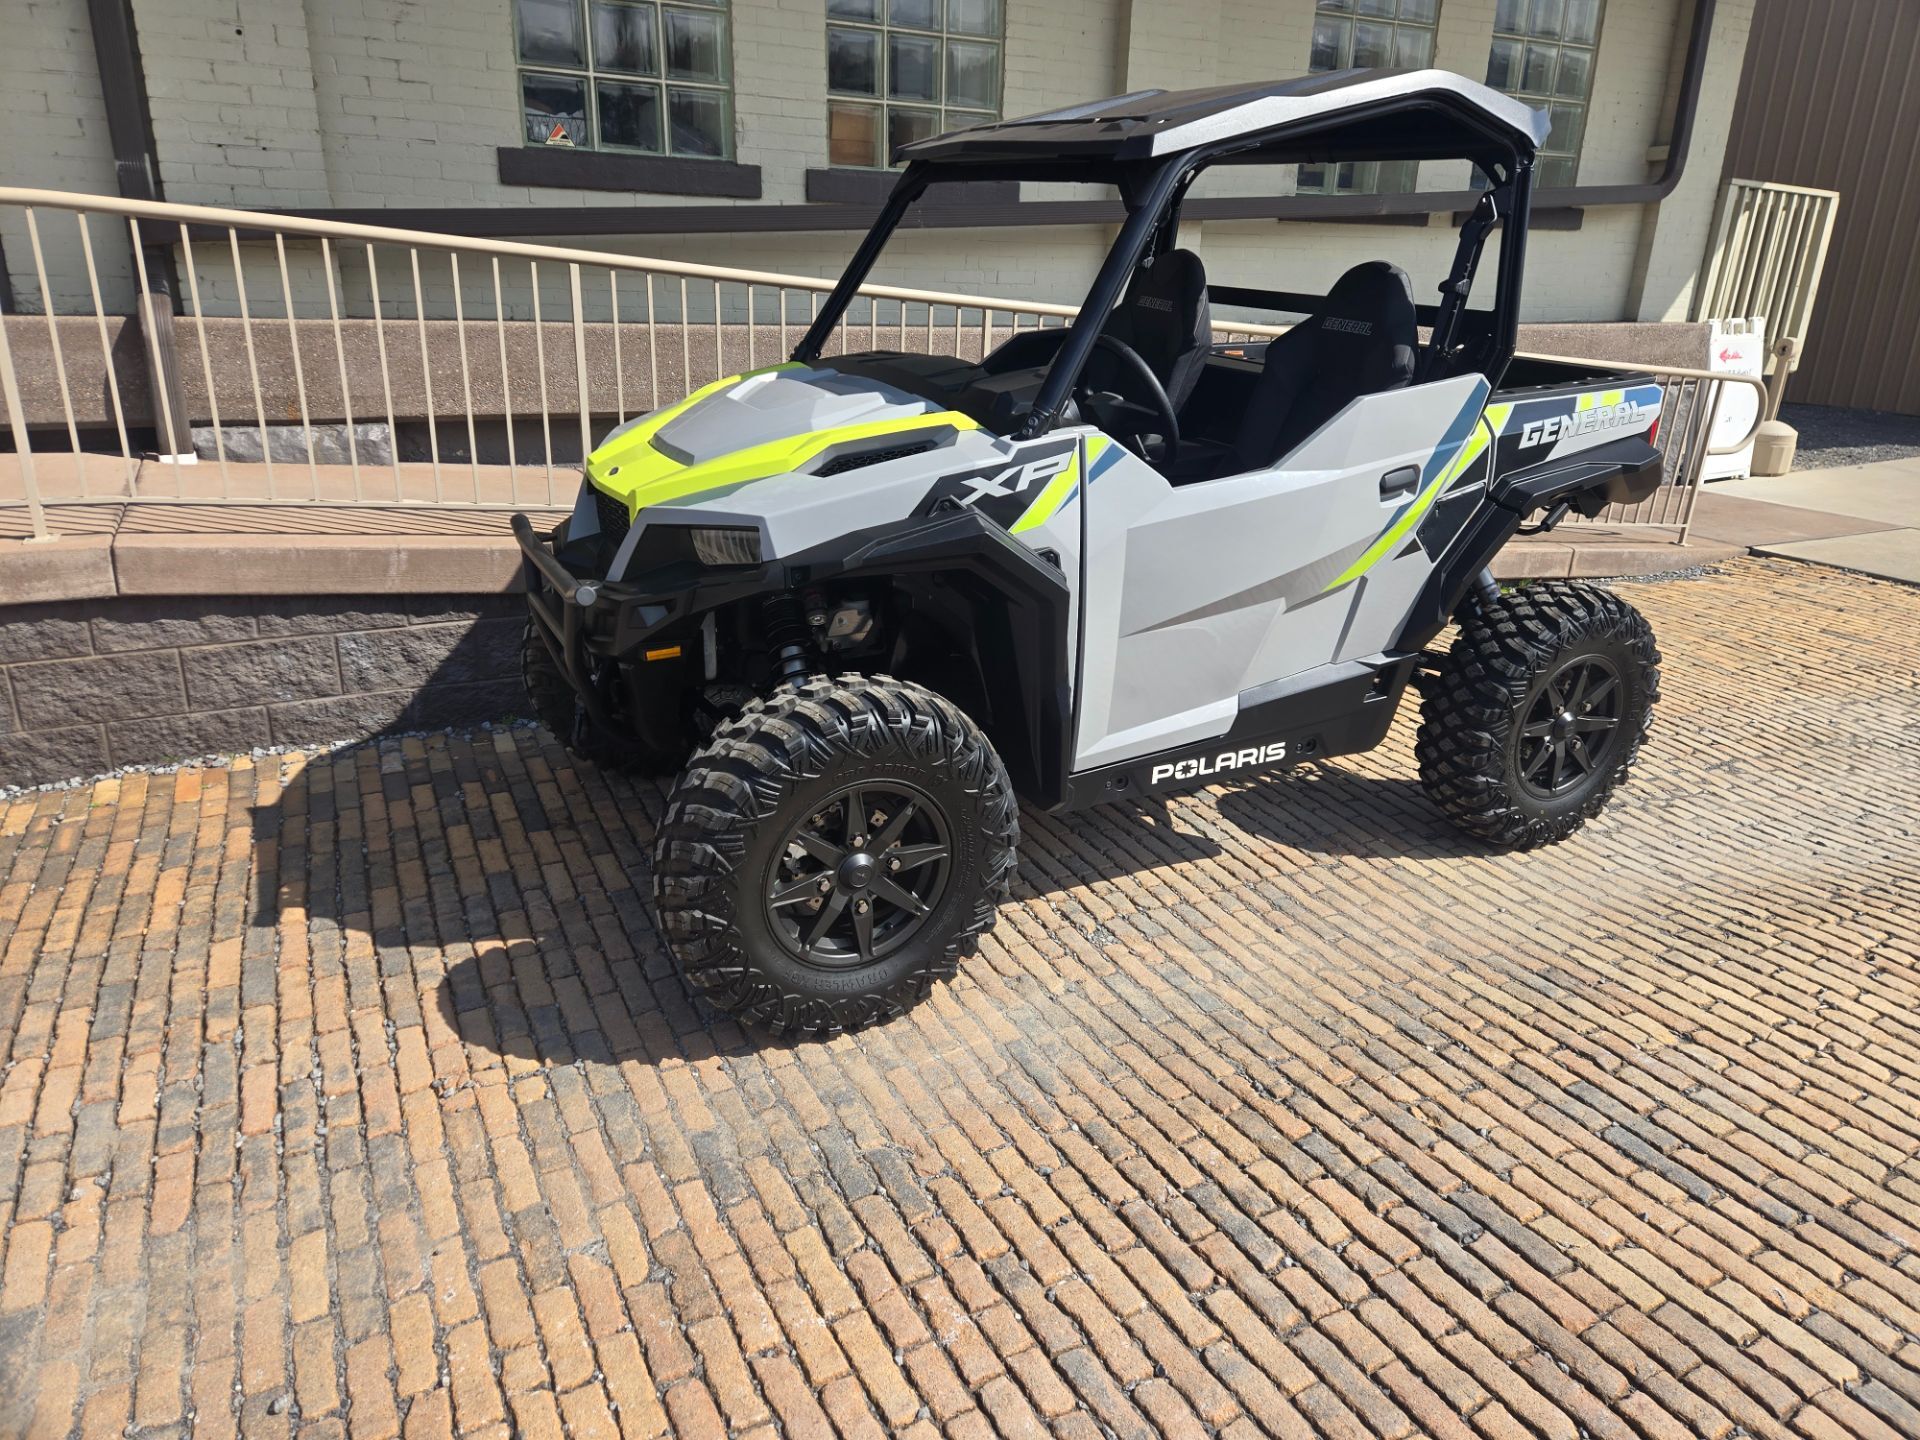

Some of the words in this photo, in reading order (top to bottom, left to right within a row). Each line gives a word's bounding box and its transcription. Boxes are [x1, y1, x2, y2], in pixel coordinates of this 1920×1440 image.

[1136, 295, 1174, 312] GENERAL
[1322, 317, 1373, 335] GENERAL
[1518, 400, 1647, 450] GENERAL
[960, 451, 1074, 505] XP
[1152, 742, 1286, 785] POLARIS
